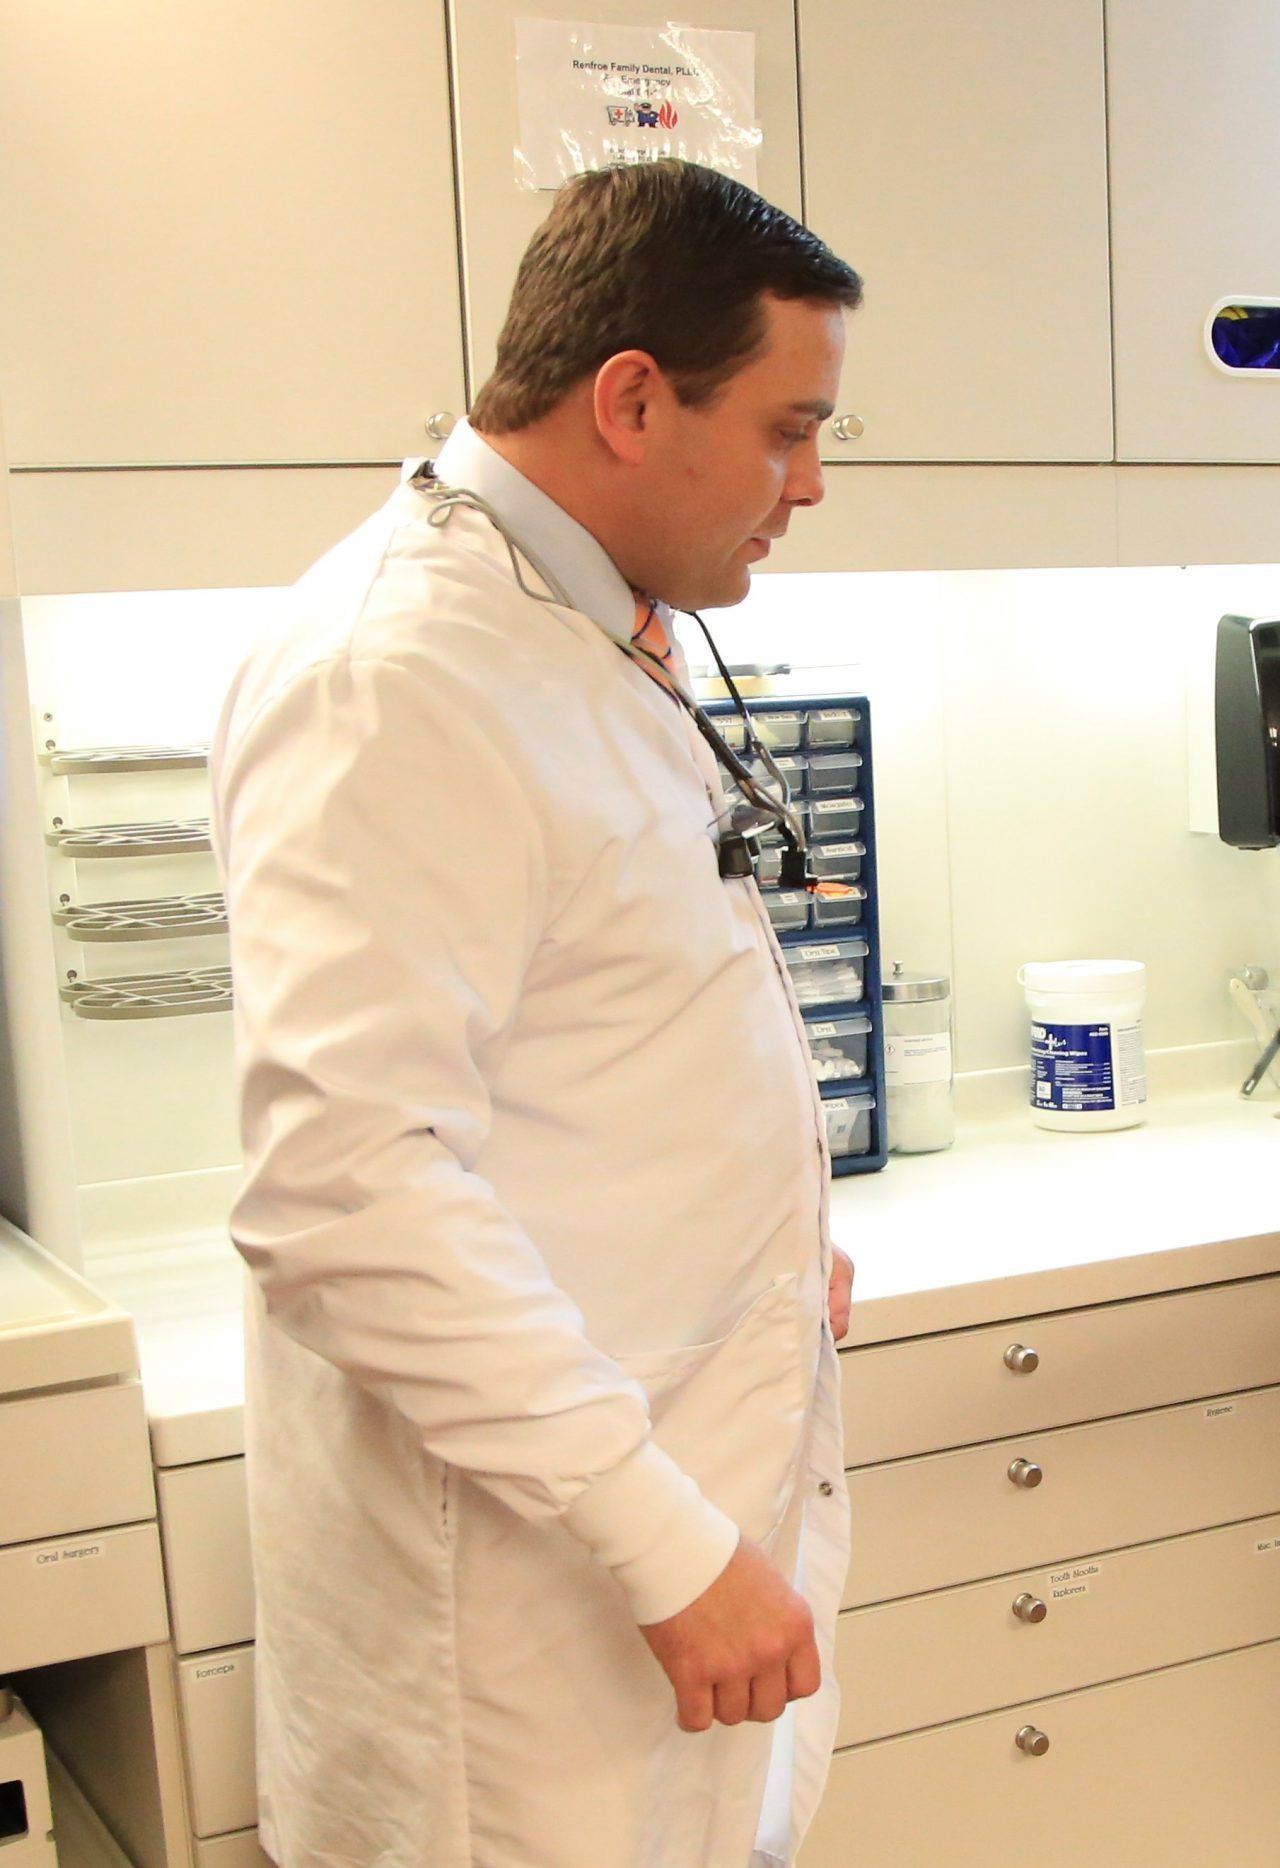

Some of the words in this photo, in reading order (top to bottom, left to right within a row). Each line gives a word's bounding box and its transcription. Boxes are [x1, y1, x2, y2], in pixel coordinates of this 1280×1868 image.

[572, 59, 608, 71] Renfroe
[610, 62, 641, 75] Family
[36, 1551, 58, 1565] Oral
[195, 1663, 235, 1679] Forceps
